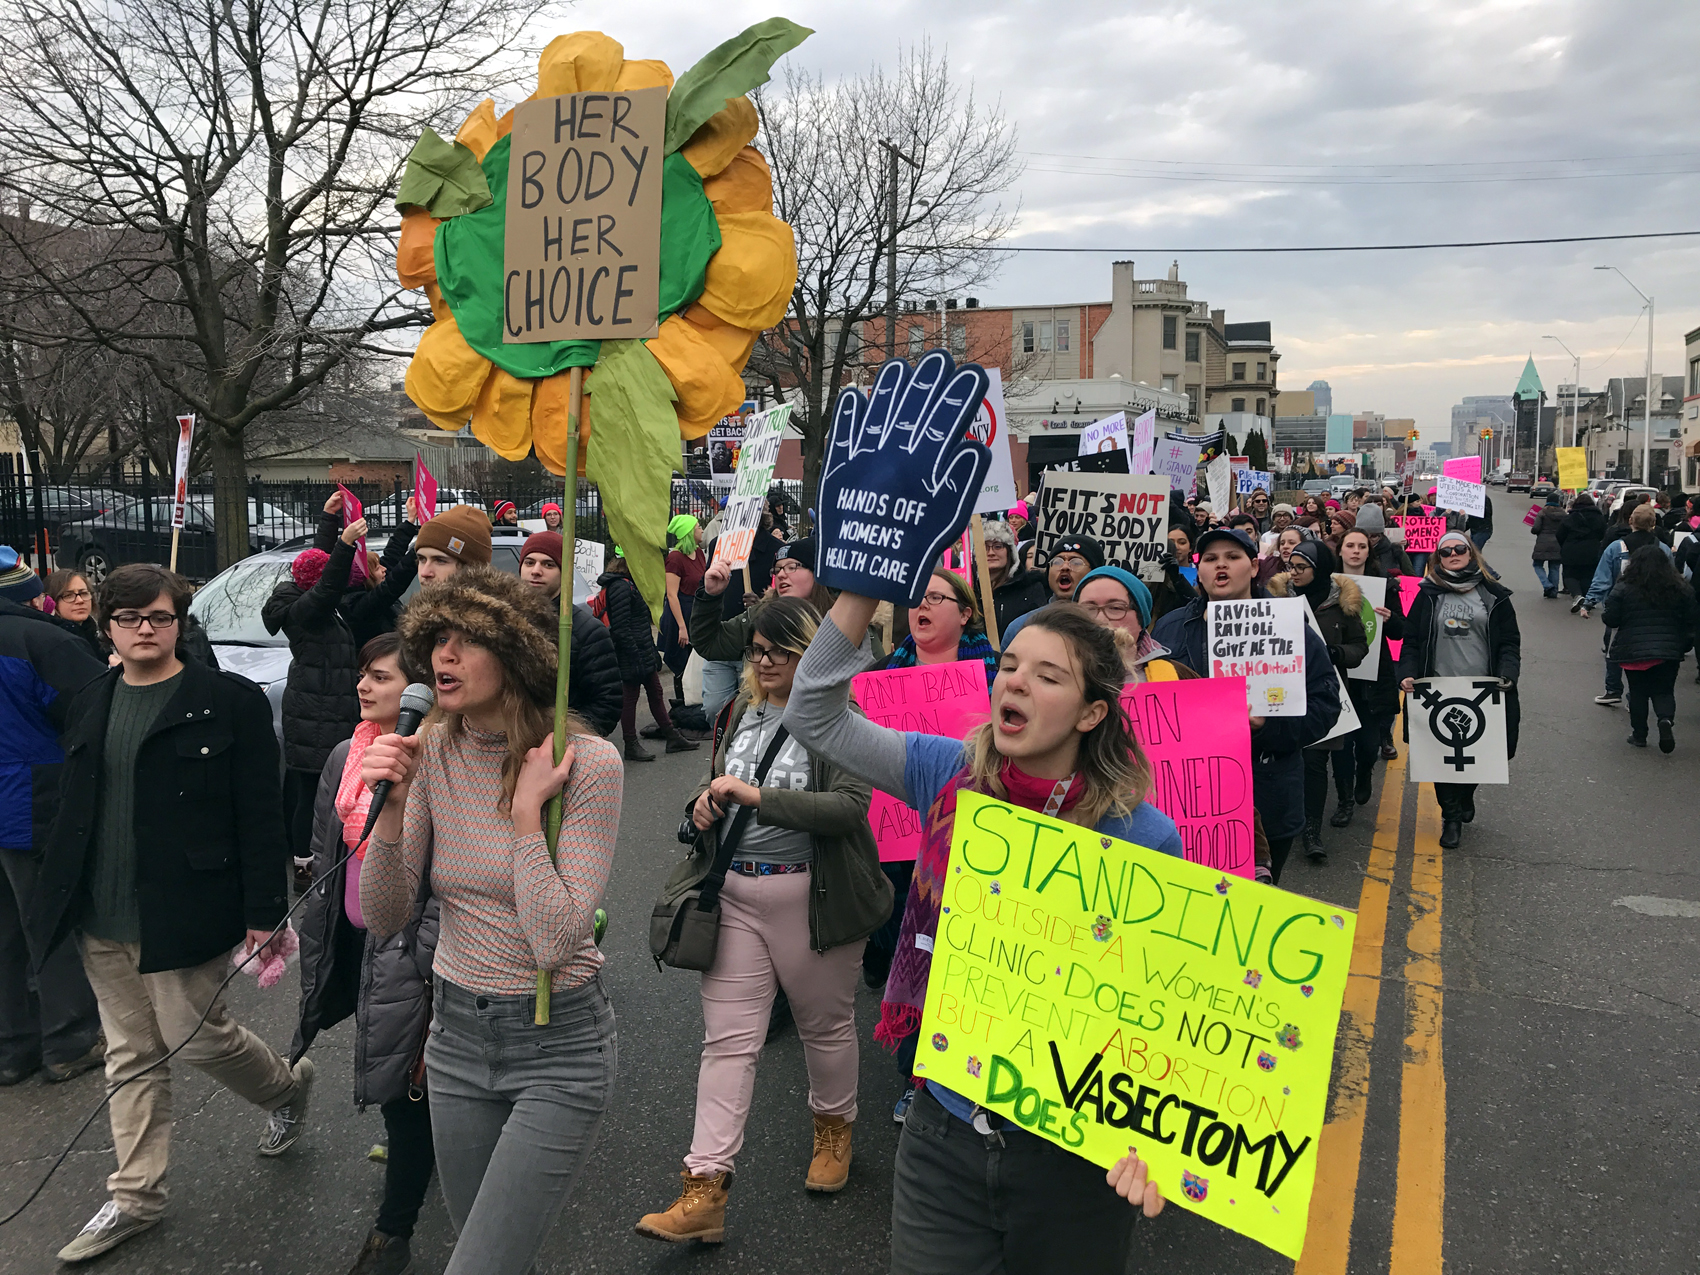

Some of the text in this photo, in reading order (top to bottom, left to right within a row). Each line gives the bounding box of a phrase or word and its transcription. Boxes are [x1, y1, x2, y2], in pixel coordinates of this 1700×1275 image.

[554, 95, 640, 143] HER
[521, 146, 649, 209] BODY
[544, 214, 623, 261] HER
[505, 265, 638, 337] CHOICE
[710, 428, 725, 437] GET
[1087, 429, 1100, 442] NO
[1102, 418, 1126, 436] MORE
[736, 443, 754, 472] ME
[753, 435, 782, 465] WITH
[1054, 460, 1081, 472] WE
[1159, 459, 1192, 475] I STAND
[738, 465, 775, 497] CHOICE
[1440, 483, 1465, 492] UTERUS
[1456, 480, 1472, 488] MADE
[720, 496, 764, 534] BUT WITH
[836, 487, 927, 526] HANDS OFF
[1042, 487, 1165, 515] IF IT'S NOT
[838, 520, 904, 550] WOMEN'S
[1042, 507, 1162, 542] YOUR BODY
[1405, 526, 1440, 538] OMENS
[711, 528, 755, 563] A CHILD
[1124, 541, 1165, 561] YOUR
[825, 547, 910, 584] HEALTH CARE
[1443, 610, 1474, 621] ROLLS
[1444, 603, 1474, 613] SUSHI
[1250, 638, 1266, 656] ME
[1268, 637, 1293, 656] THE
[852, 664, 979, 710] AN'T BAN
[734, 730, 796, 766] GIL
[963, 804, 1326, 984] STANDING
[954, 876, 1280, 1029] OUTSIDE A WOMEN'S
[946, 914, 1271, 1068] CLINIC DOES NOT
[943, 954, 1285, 1129] PREVENT ABORTION
[937, 993, 1311, 1197] BUT A VASECTOMY
[986, 1054, 1090, 1147] DOES
